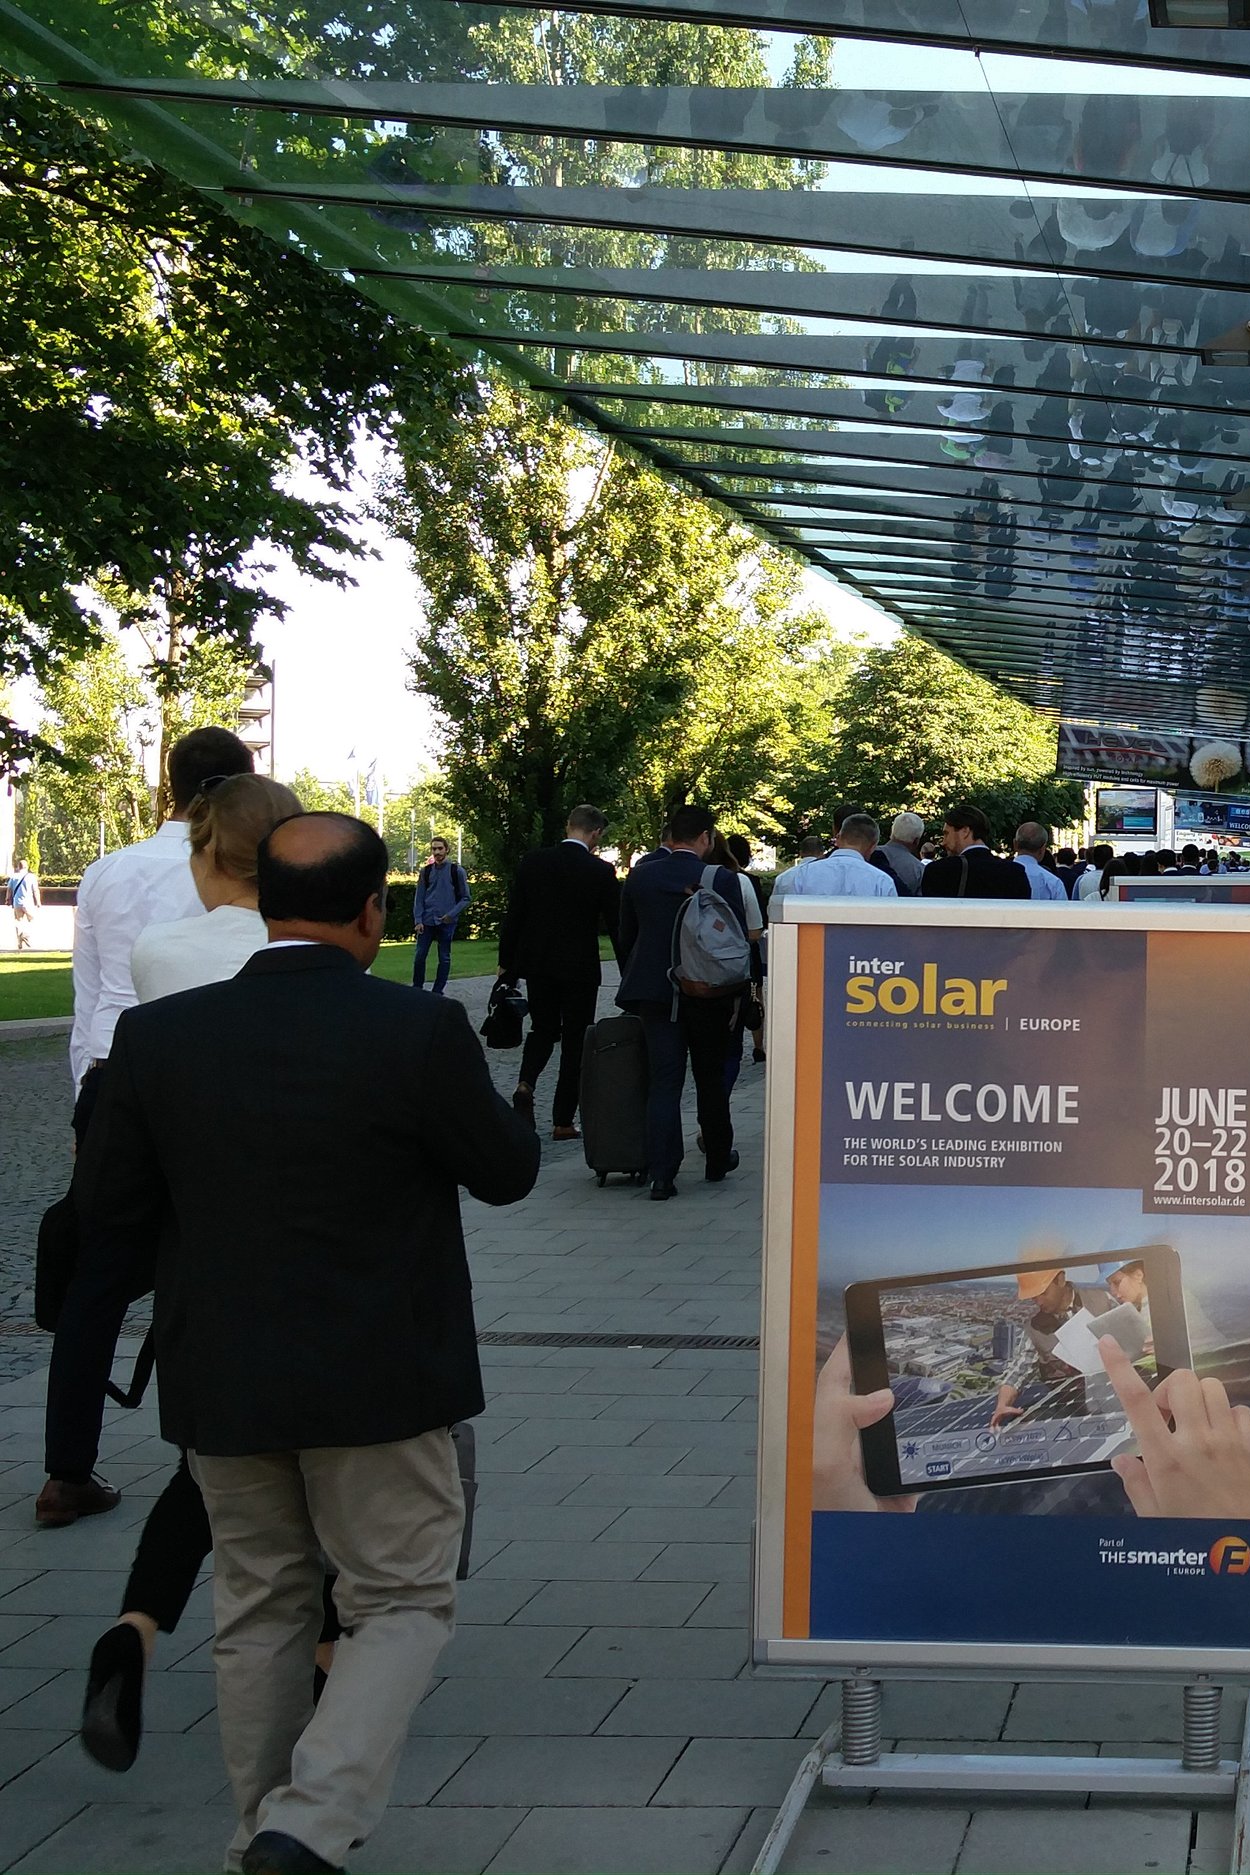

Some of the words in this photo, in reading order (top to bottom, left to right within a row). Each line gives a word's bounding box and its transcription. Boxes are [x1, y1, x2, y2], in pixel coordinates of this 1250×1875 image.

[849, 956, 905, 975] inter
[845, 963, 1008, 1016] solar
[846, 1020, 908, 1029] connecting
[913, 1020, 942, 1029] solar
[946, 1021, 995, 1030] business
[1019, 1018, 1081, 1031] EUROPE
[845, 1081, 1080, 1124] WELCOME
[1154, 1087, 1248, 1127] JUNE
[843, 1137, 867, 1149] THE
[931, 1138, 987, 1152] LEADING
[990, 1139, 1063, 1153] EXHIBITION
[843, 1154, 868, 1166] FOR
[871, 1154, 895, 1167] THE
[898, 1155, 940, 1167] SOLAR
[943, 1156, 1006, 1169] INDUSTRY
[1153, 1156, 1246, 1193] 2018
[1153, 1194, 1246, 1207] www.intersolar.de
[927, 1463, 949, 1474] START
[1099, 1538, 1115, 1547] Part
[1115, 1538, 1124, 1547] of
[1173, 1567, 1206, 1576] EUROPE
